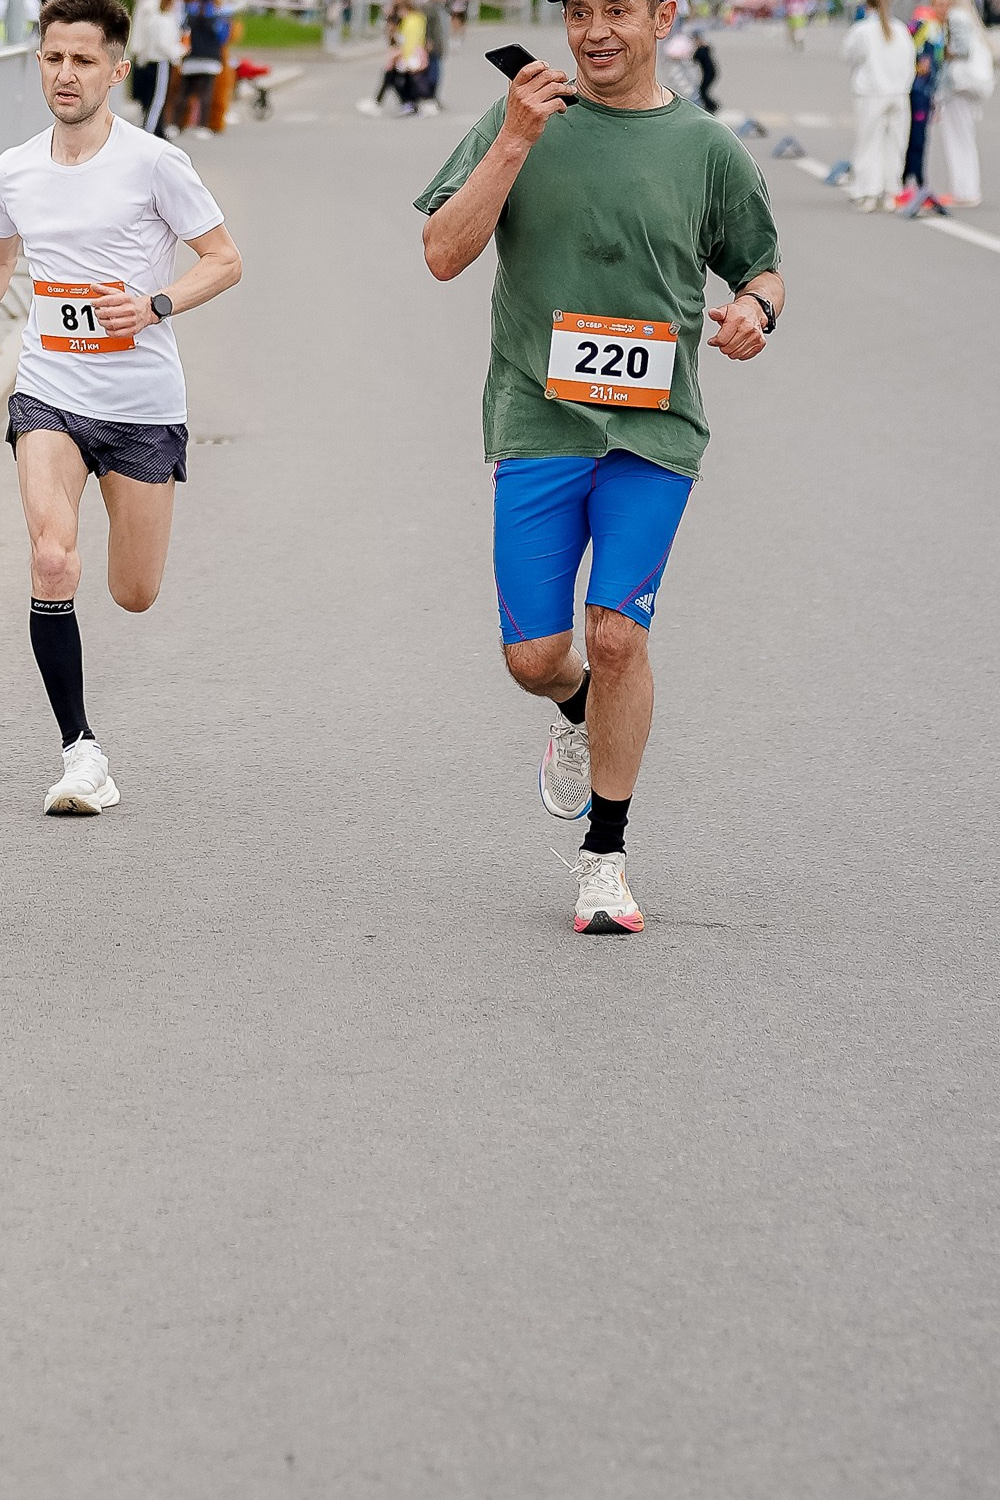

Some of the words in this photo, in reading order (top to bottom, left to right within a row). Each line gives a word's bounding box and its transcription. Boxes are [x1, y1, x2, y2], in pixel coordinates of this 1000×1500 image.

[61, 304, 96, 332] 81
[575, 341, 649, 379] 220
[33, 601, 65, 609] CRAFT
